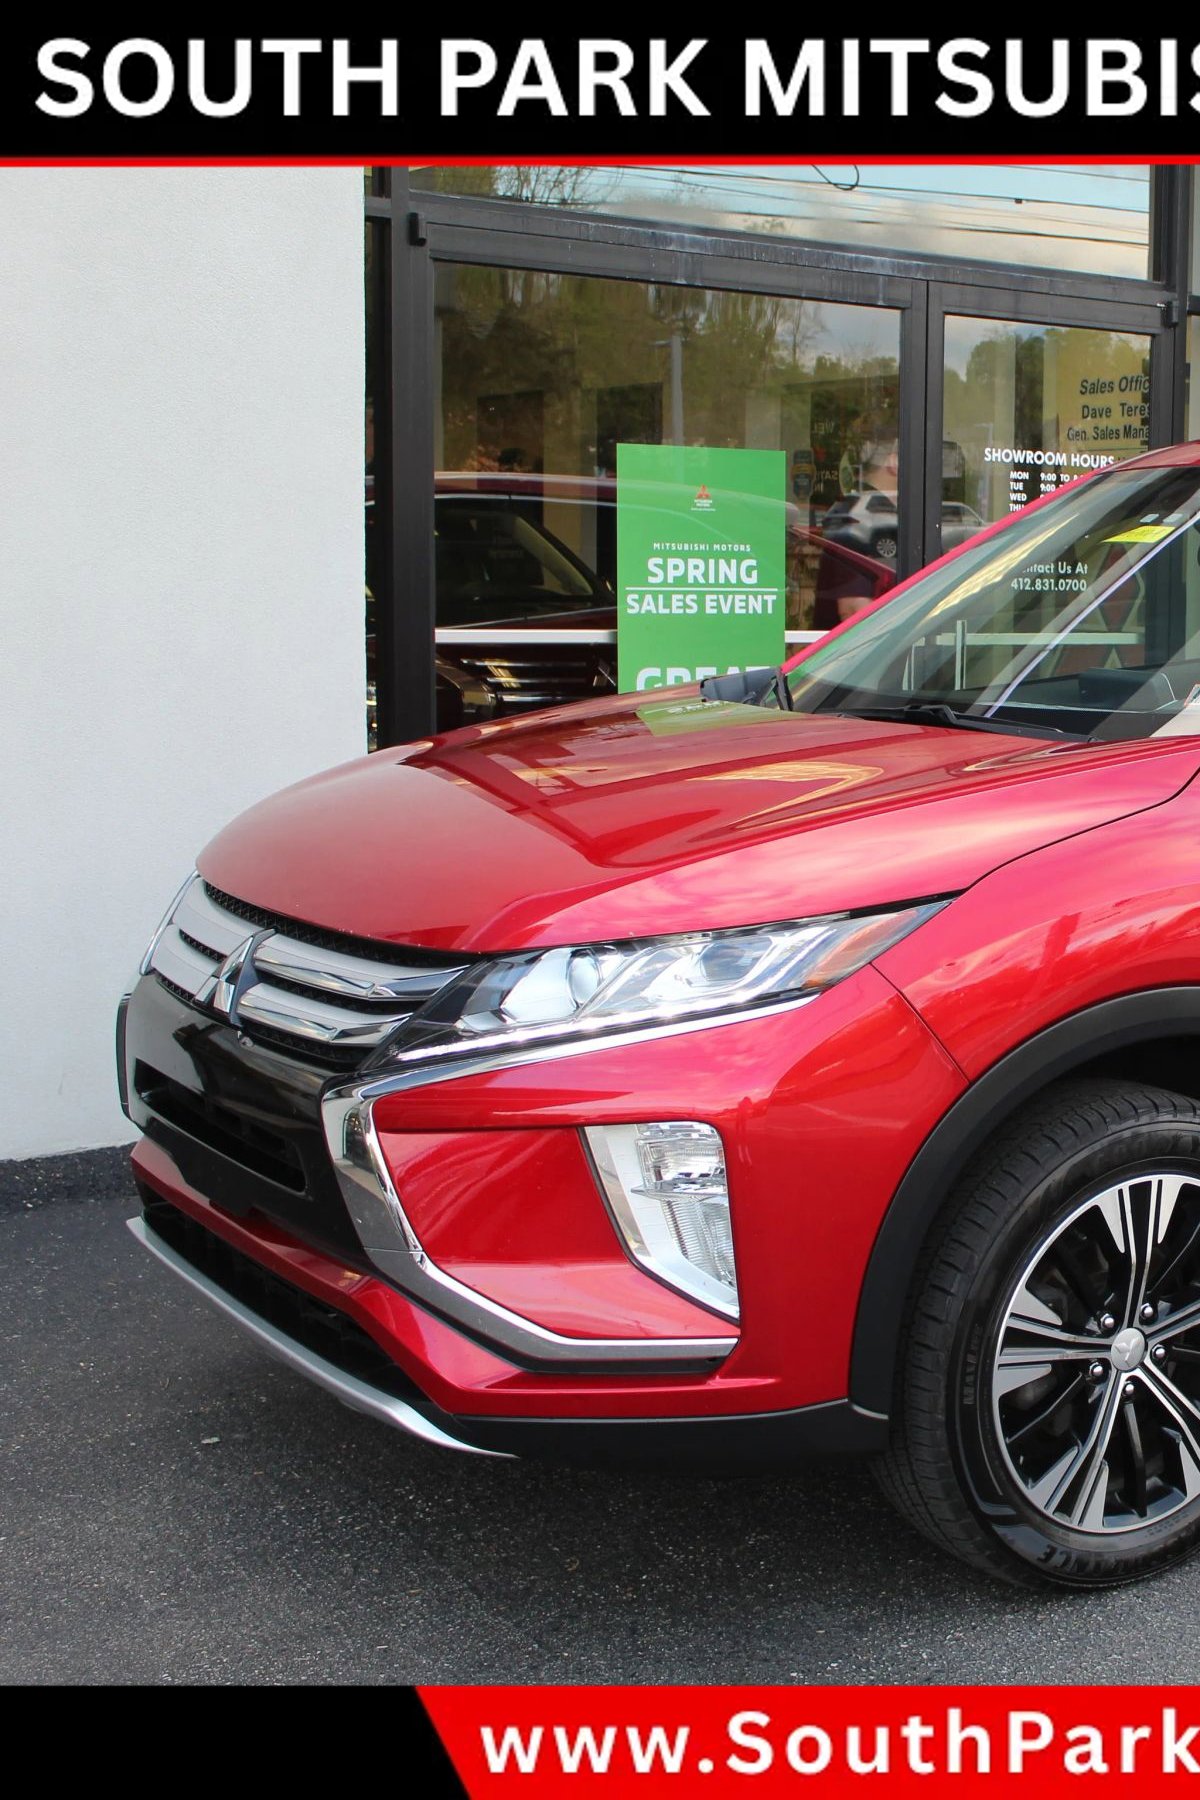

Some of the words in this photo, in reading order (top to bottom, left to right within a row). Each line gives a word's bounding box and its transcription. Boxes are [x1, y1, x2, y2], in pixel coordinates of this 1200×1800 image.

[1079, 377, 1115, 395] Sales
[1082, 404, 1112, 419] Dave
[1093, 426, 1120, 440] Sales
[984, 448, 1067, 467] SHOWROOM
[1070, 455, 1115, 468] HOURS
[1009, 471, 1029, 480] MON
[1040, 473, 1057, 482] 9:00
[1060, 473, 1070, 482] TO
[1009, 482, 1024, 491] TUE
[1040, 484, 1056, 492] 9:00
[1009, 493, 1027, 501] WED
[653, 542, 709, 551] MITSUBISHI
[713, 543, 751, 552] MOTORS
[647, 557, 758, 584] SPRING
[1058, 561, 1072, 574] Us
[1075, 562, 1088, 574] At
[1010, 577, 1088, 591] 412.831.0700
[626, 593, 698, 614] SALES
[705, 594, 777, 614] EVENT
